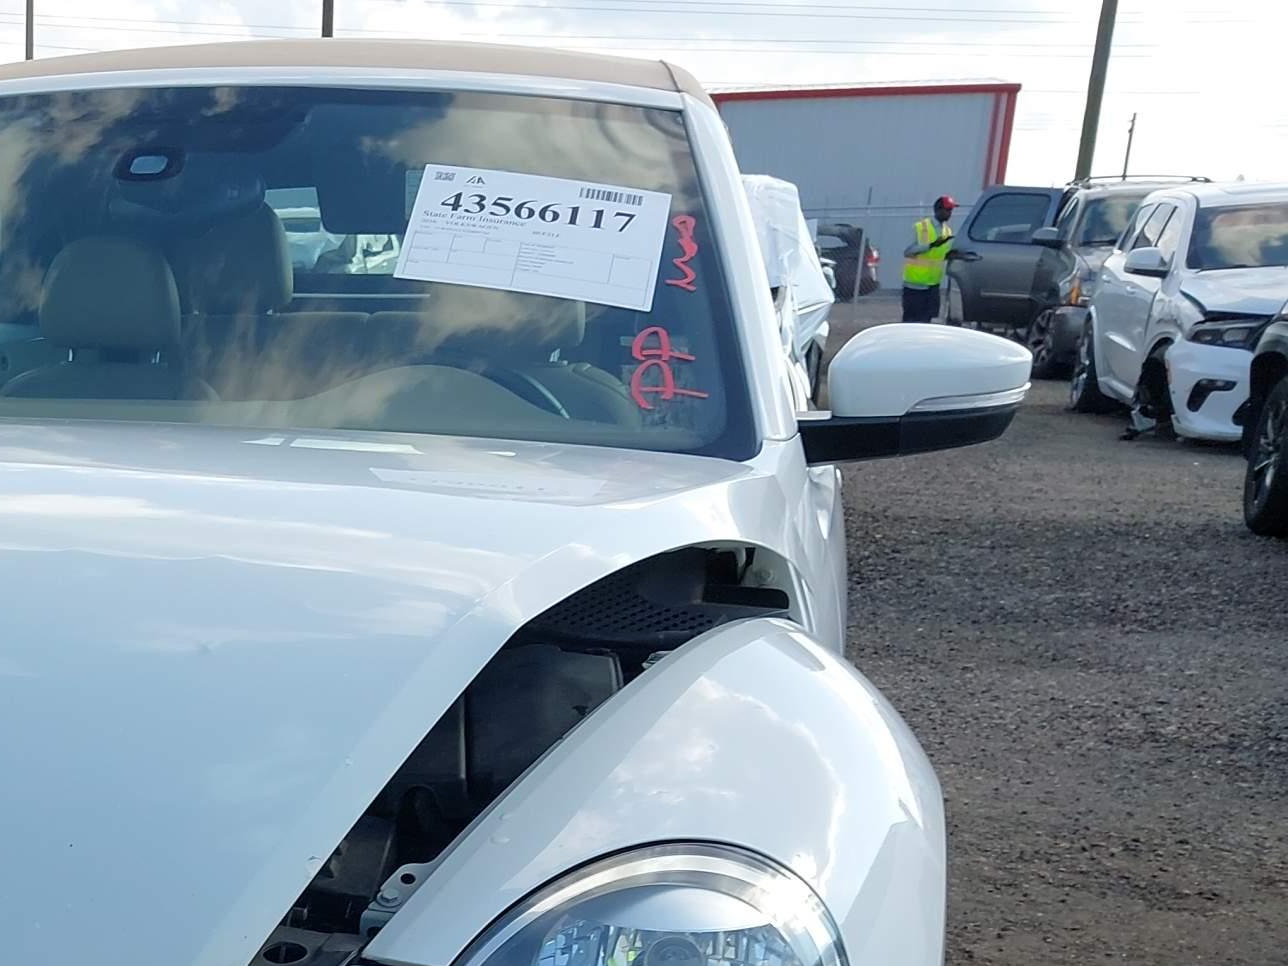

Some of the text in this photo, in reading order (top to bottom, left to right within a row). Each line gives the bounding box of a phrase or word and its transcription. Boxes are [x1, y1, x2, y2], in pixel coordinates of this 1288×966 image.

[423, 210, 527, 227] State Farm Insurance
[441, 191, 637, 233] 43566117
